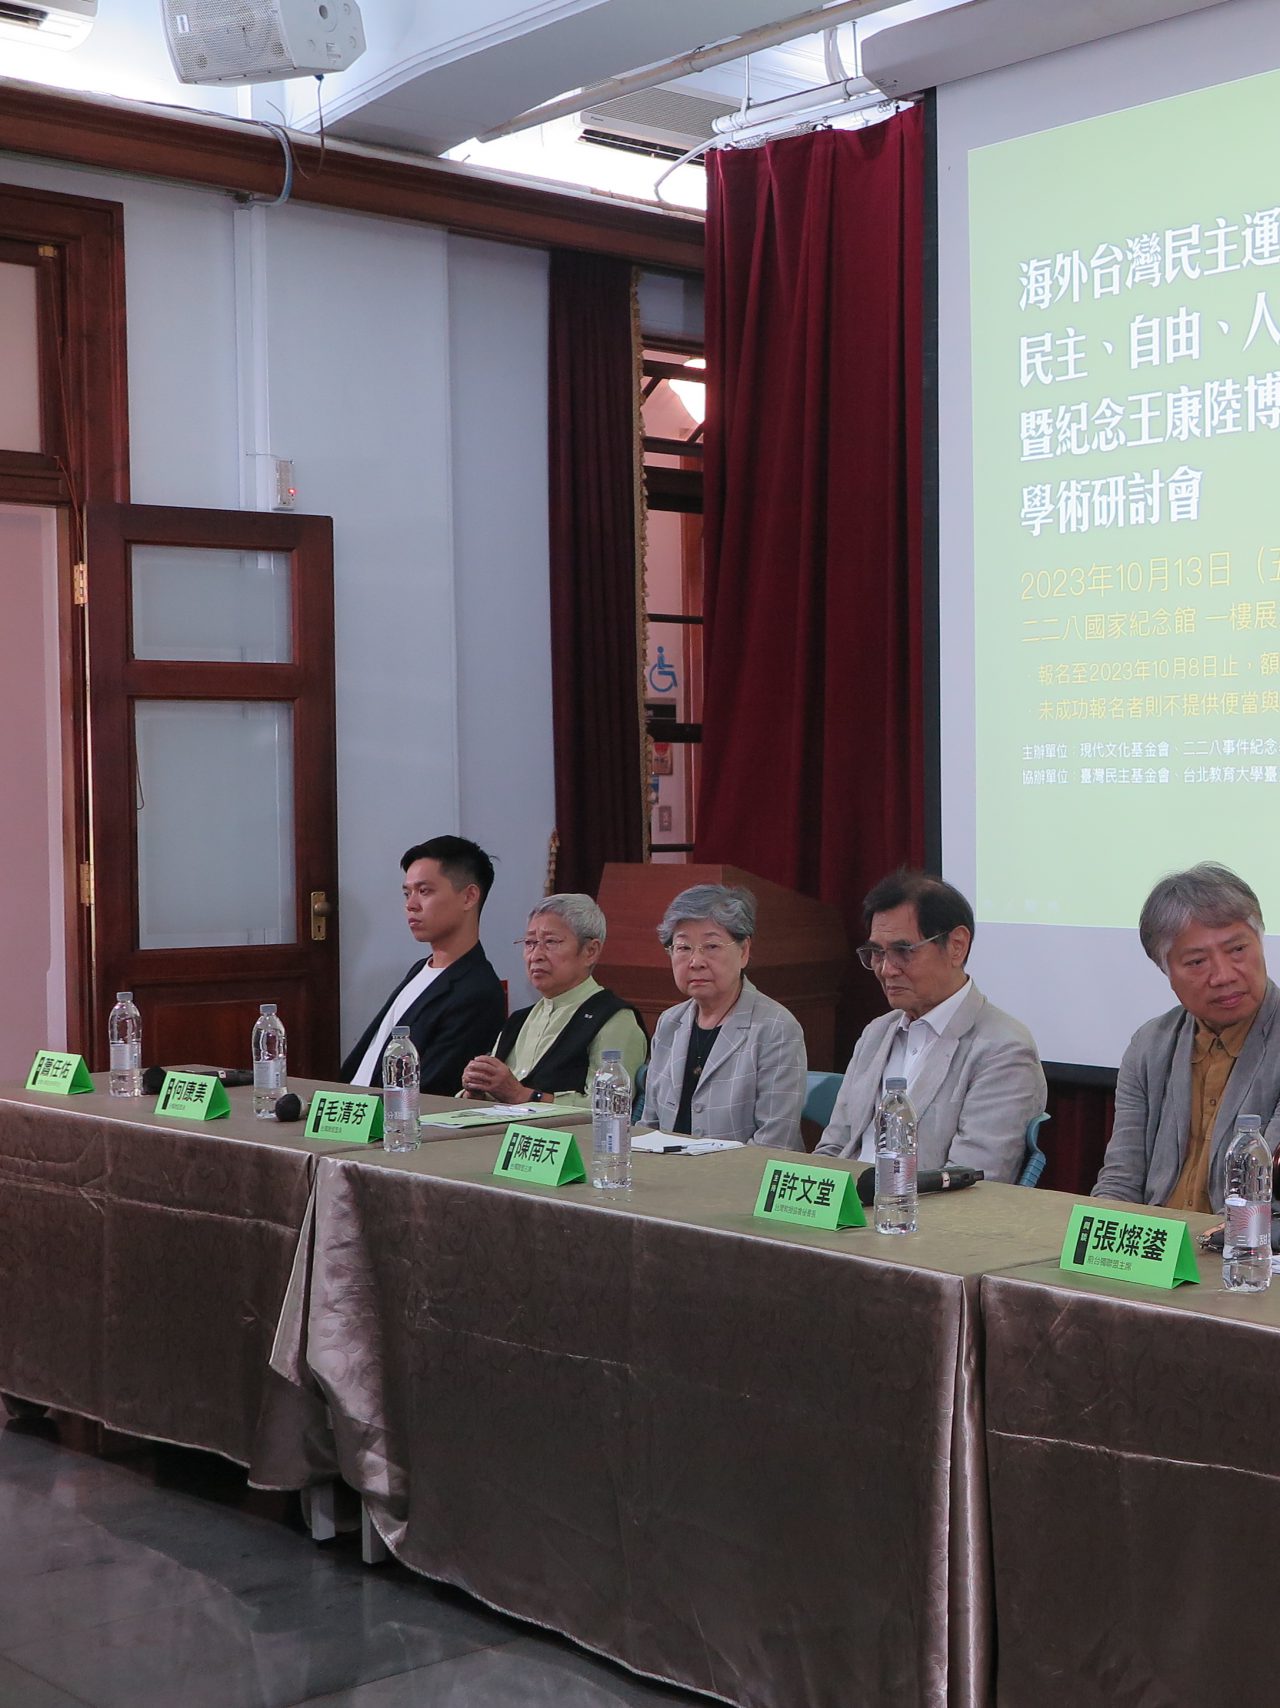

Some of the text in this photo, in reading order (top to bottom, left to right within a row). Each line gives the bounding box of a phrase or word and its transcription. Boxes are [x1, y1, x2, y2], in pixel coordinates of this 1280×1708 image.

[1019, 464, 1204, 537] 學術研討會
[172, 1079, 208, 1103] 何康美
[324, 1100, 369, 1125] 毛清芬
[513, 1133, 561, 1165] 陳南天
[778, 1171, 836, 1207] 許文堂
